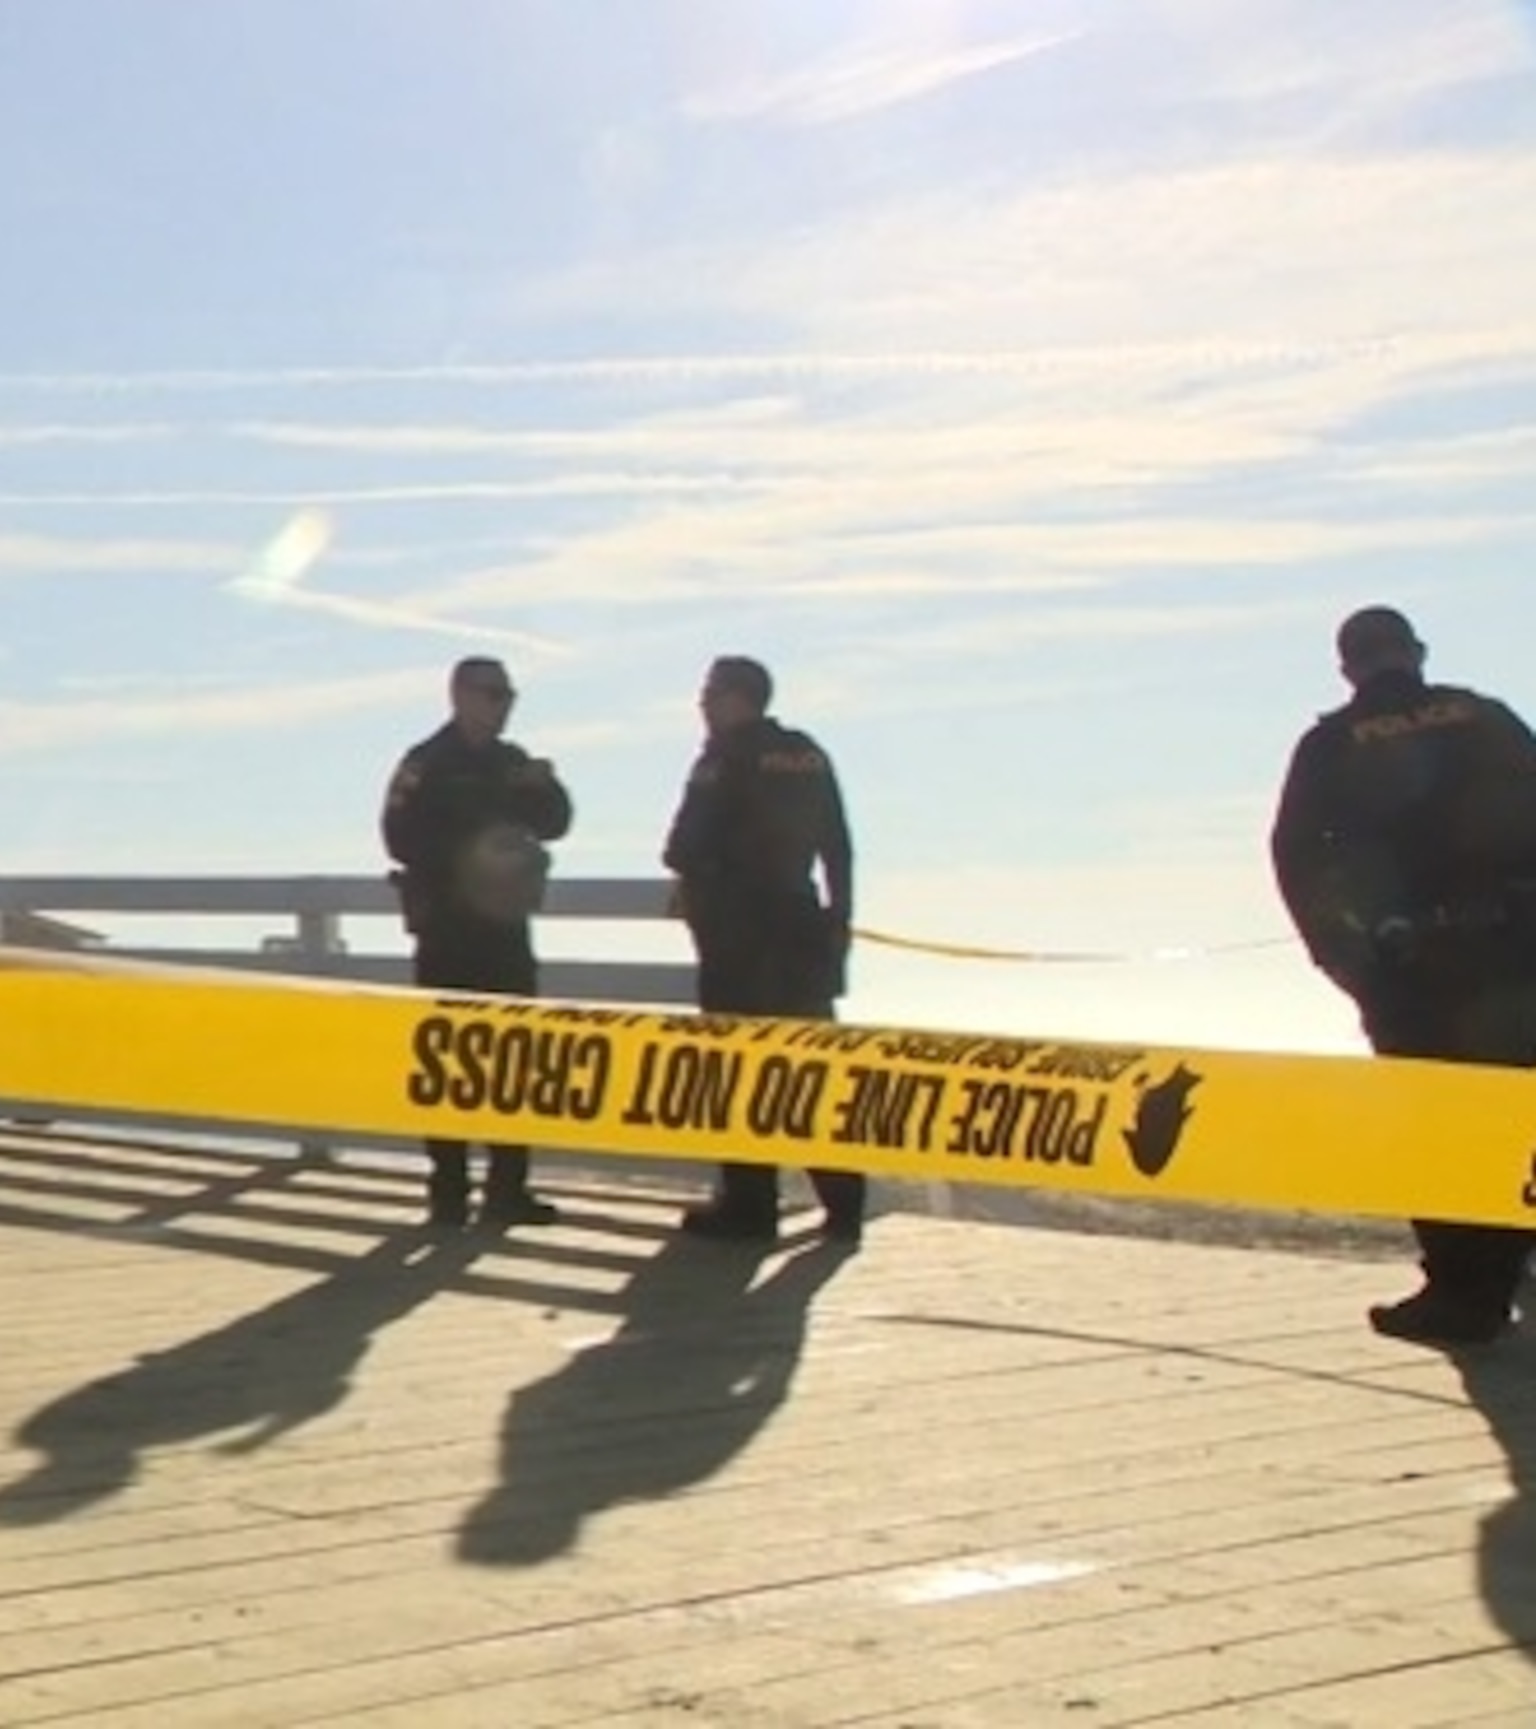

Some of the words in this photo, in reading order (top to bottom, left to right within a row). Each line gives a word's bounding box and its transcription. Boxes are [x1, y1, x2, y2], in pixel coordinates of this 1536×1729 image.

[407, 1017, 611, 1121] CROSS
[621, 1042, 743, 1132] NOT
[746, 1055, 829, 1139] DO
[830, 1066, 946, 1150] LINE
[946, 1079, 1108, 1166] POLICE
